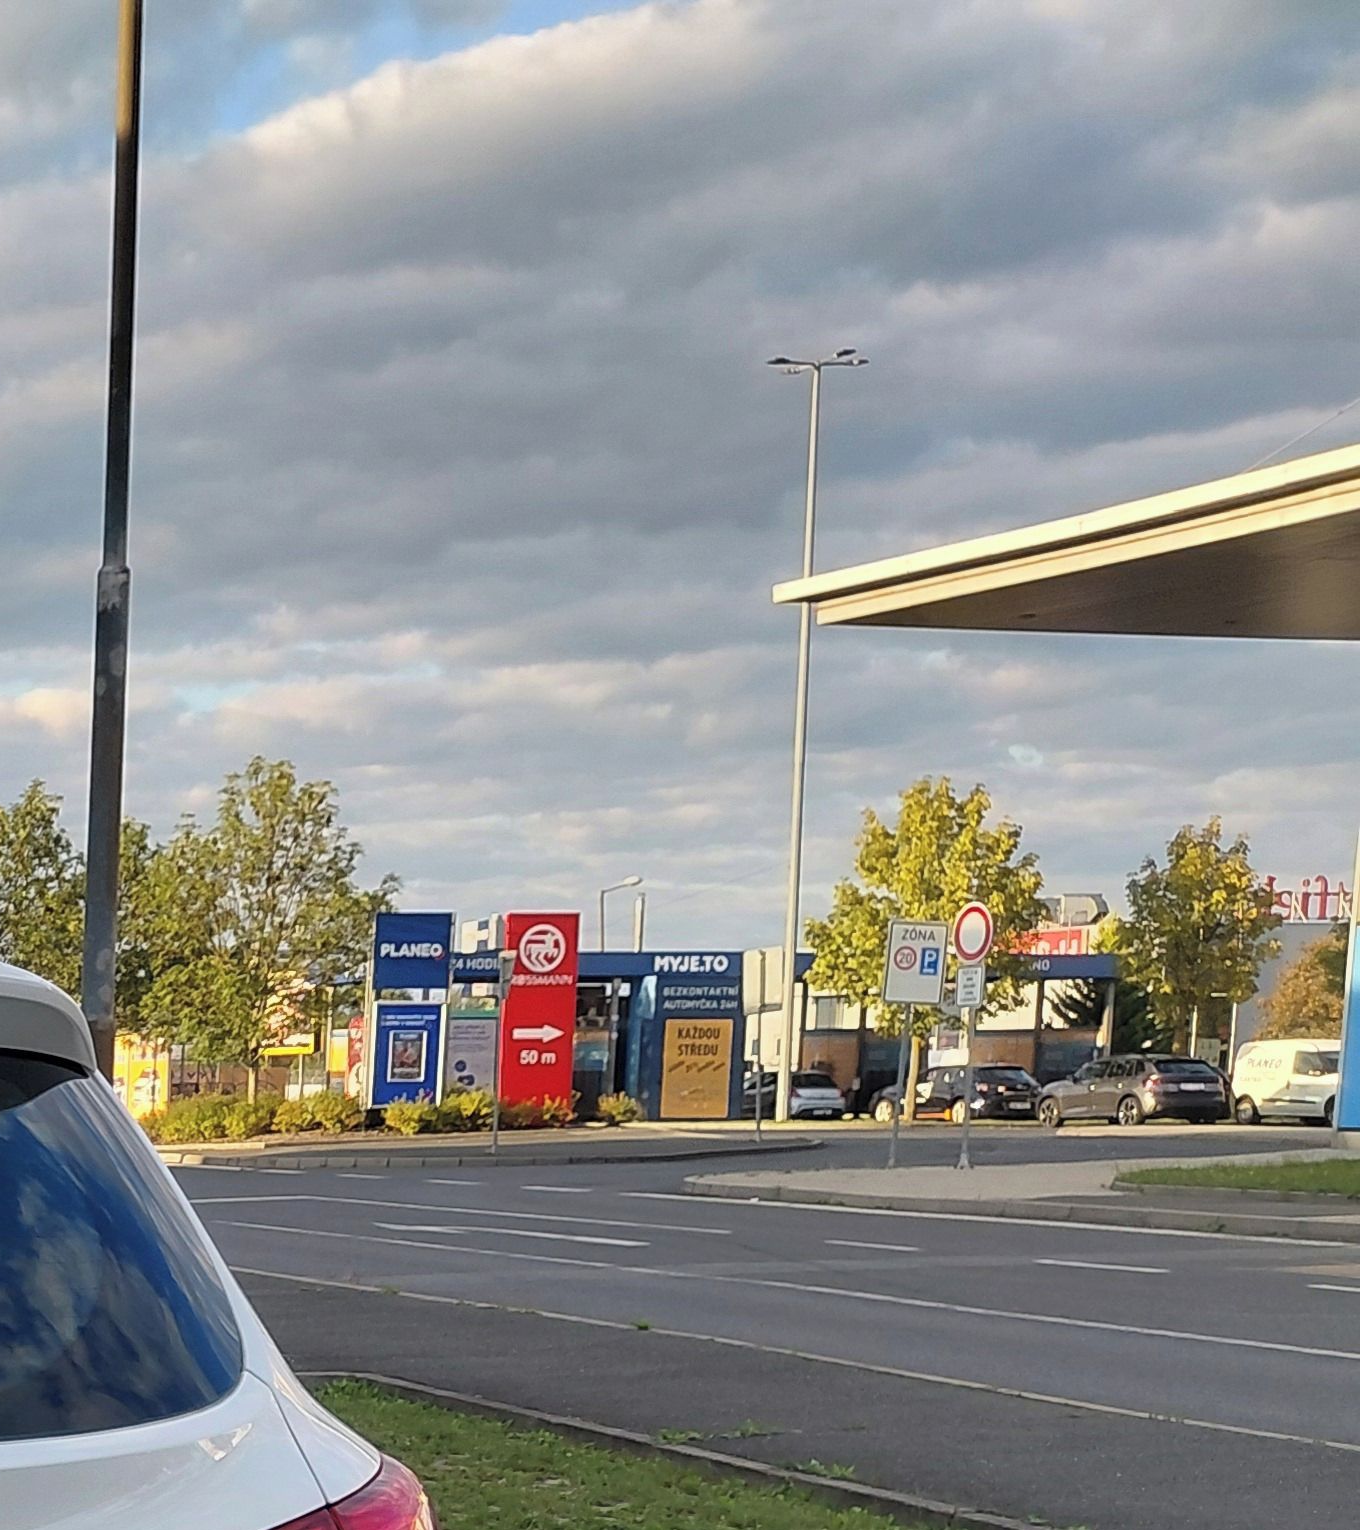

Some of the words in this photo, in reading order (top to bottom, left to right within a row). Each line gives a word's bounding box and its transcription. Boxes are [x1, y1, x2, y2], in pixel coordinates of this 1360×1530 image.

[901, 928, 936, 941] ZÓNA
[379, 942, 444, 959] PLANEO
[465, 957, 501, 970] HODI
[653, 955, 729, 973] MYJE.TO
[899, 952, 913, 964] 20
[663, 984, 739, 997] BEZKONTAKTNÍ
[677, 1025, 721, 1040] KAŽDOU
[677, 1043, 719, 1057] STŘEDU
[519, 1050, 538, 1065] 50
[540, 1051, 557, 1065] m
